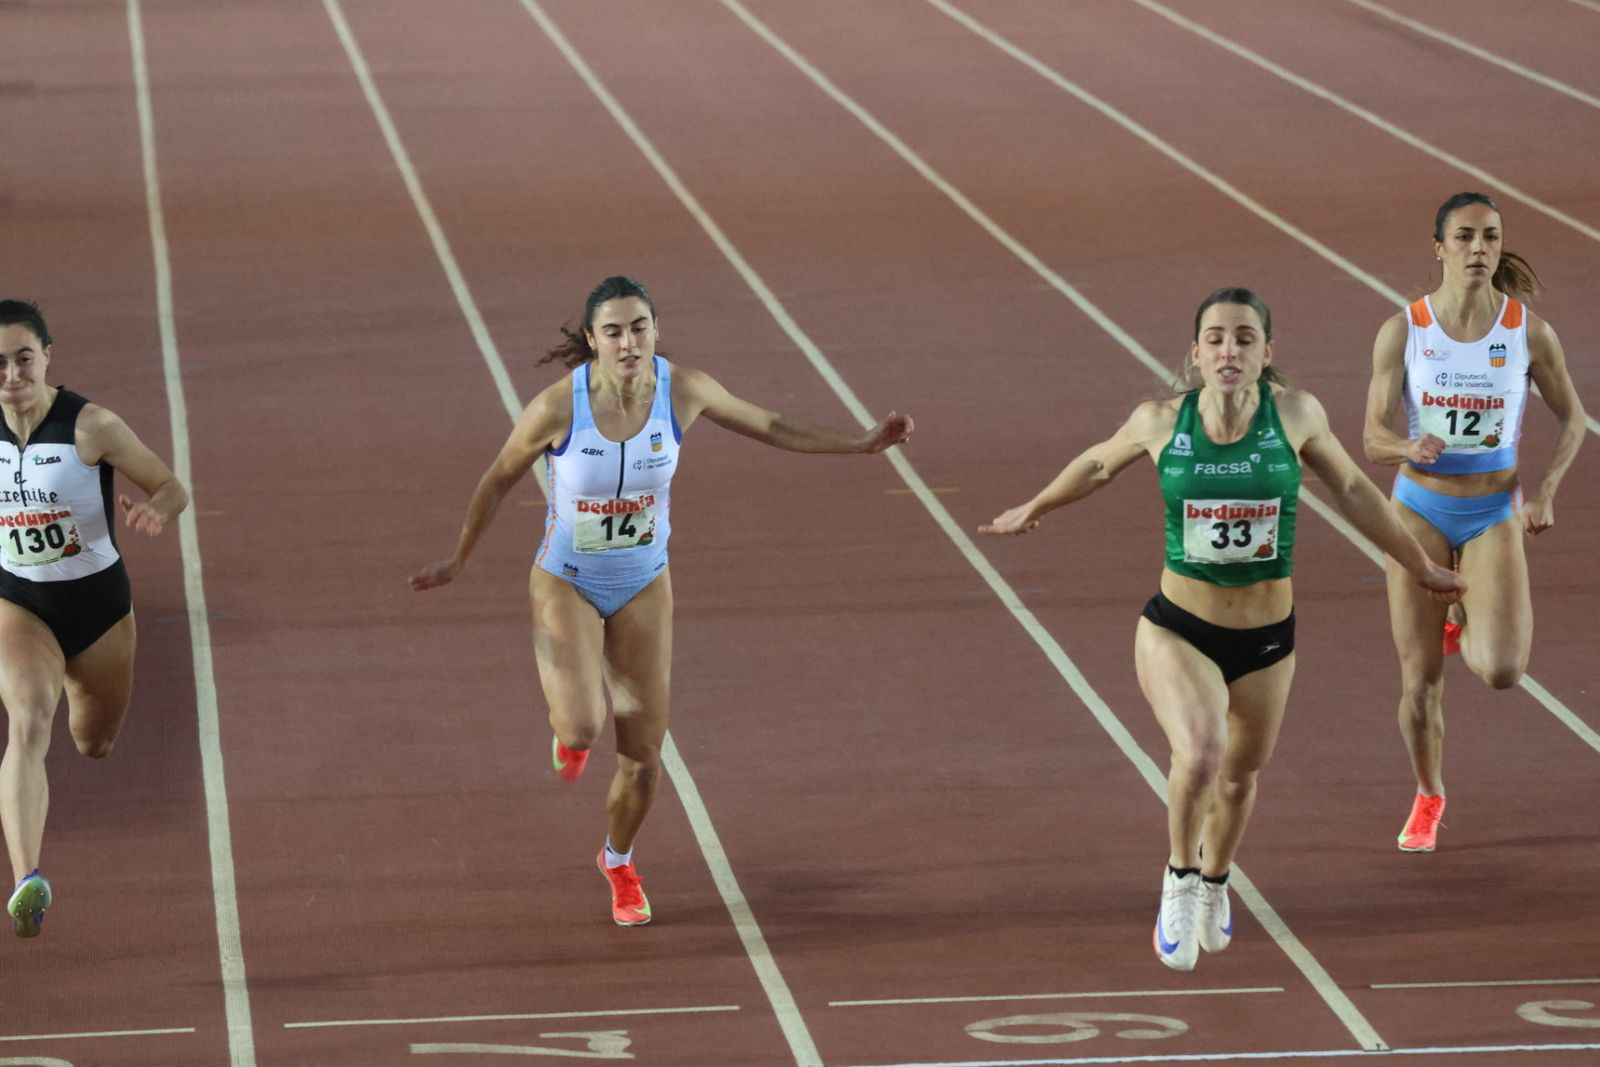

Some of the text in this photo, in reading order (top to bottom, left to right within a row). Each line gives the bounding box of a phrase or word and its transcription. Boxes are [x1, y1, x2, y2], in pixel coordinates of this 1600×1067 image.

[1422, 392, 1504, 410] bedunia
[1445, 410, 1481, 436] 12
[1186, 504, 1278, 519] bedunia
[9, 522, 66, 556] 130
[600, 513, 637, 541] 14
[1210, 519, 1252, 550] 33
